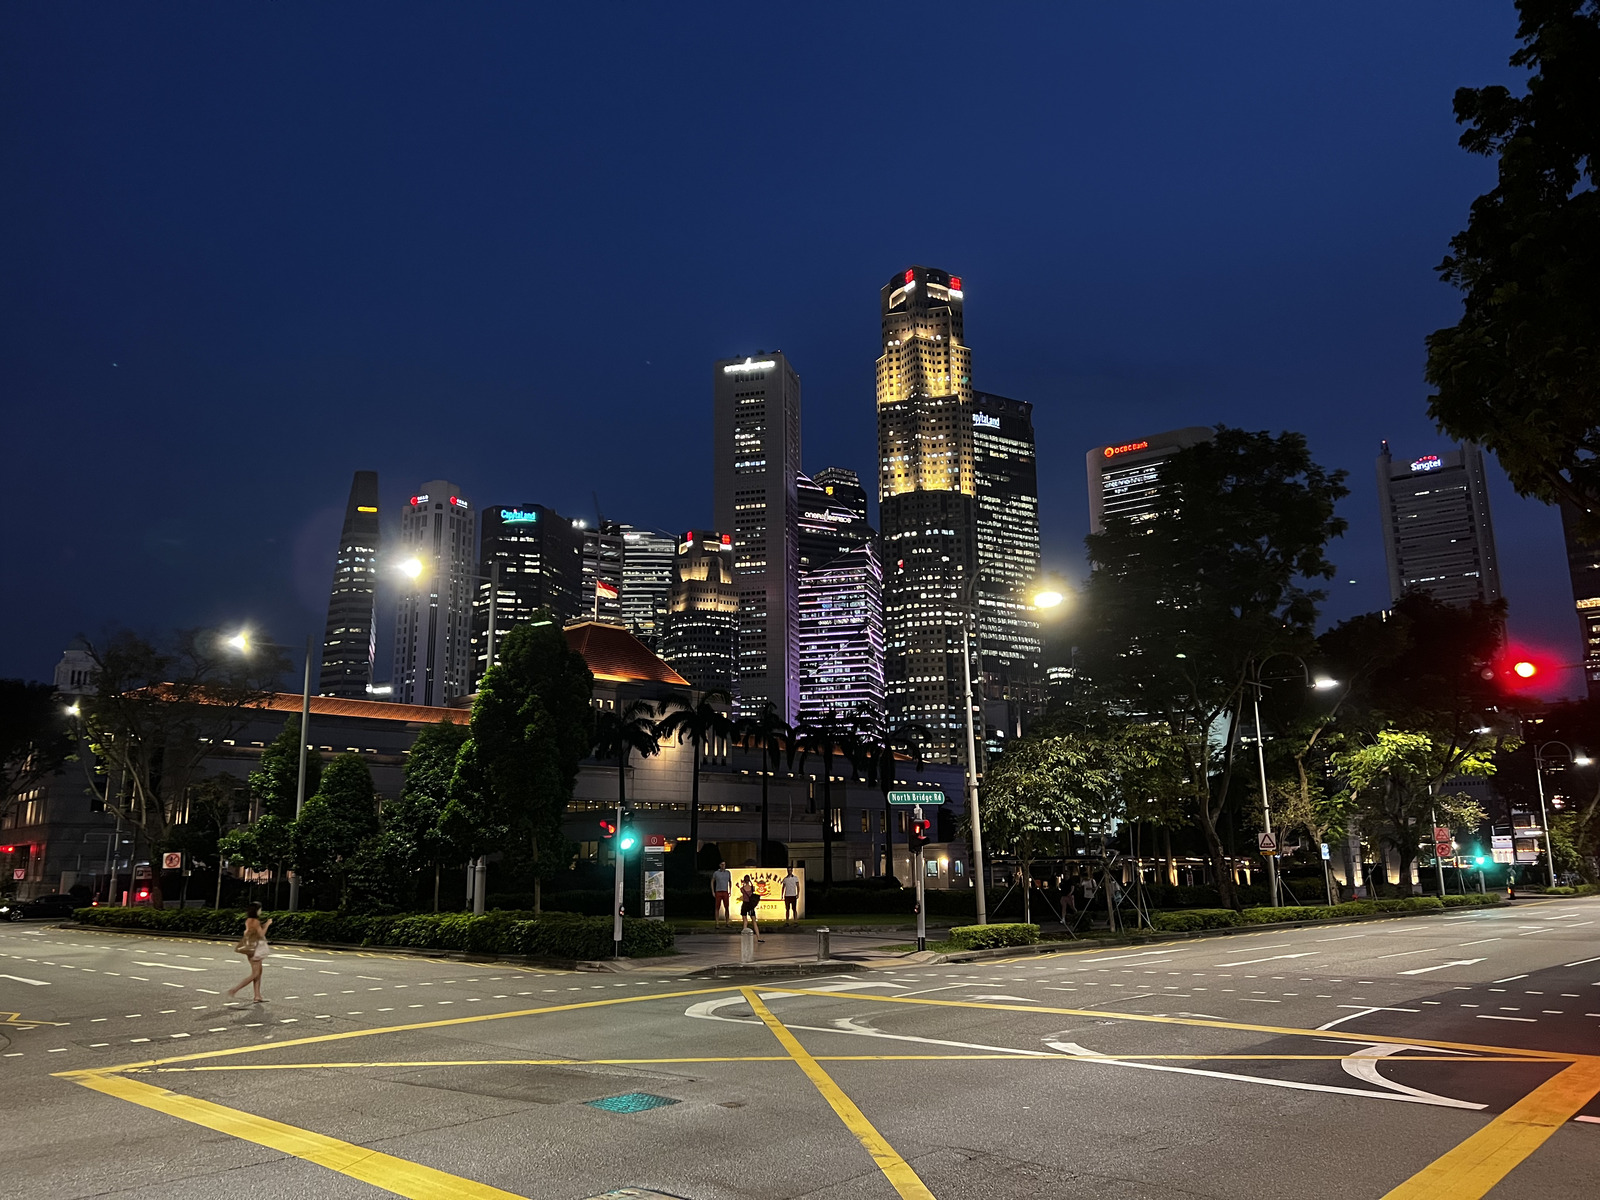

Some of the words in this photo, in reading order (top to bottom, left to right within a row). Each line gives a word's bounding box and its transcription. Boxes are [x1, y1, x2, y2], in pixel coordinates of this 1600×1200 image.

[1114, 444, 1132, 454] OCBC
[1410, 458, 1441, 471] Singtel
[891, 793, 911, 801] North
[912, 793, 932, 803] Bridge
[933, 793, 942, 801] Rd
